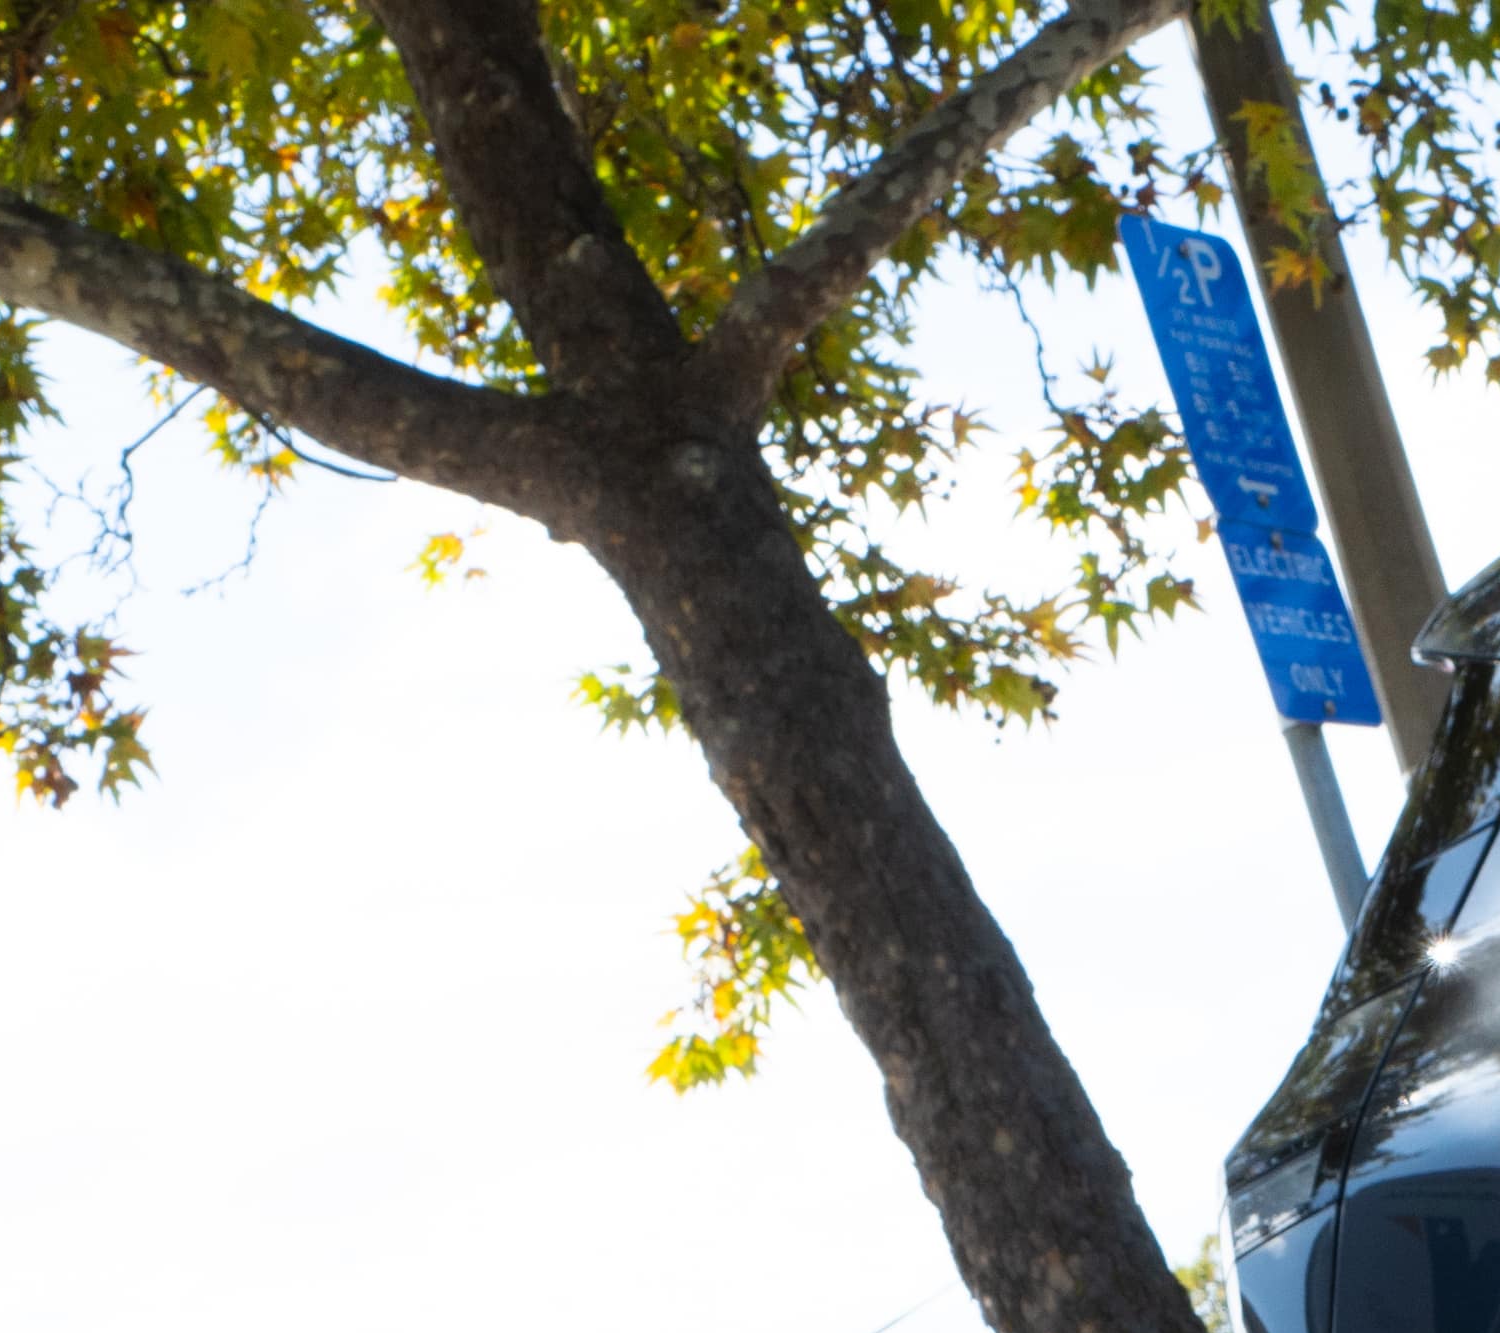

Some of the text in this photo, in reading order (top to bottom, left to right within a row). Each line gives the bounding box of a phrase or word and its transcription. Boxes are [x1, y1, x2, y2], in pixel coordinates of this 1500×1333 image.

[1228, 543, 1331, 586] ELECTRIC
[1248, 602, 1351, 644] VEHICLES
[1290, 662, 1346, 698] ONLY
